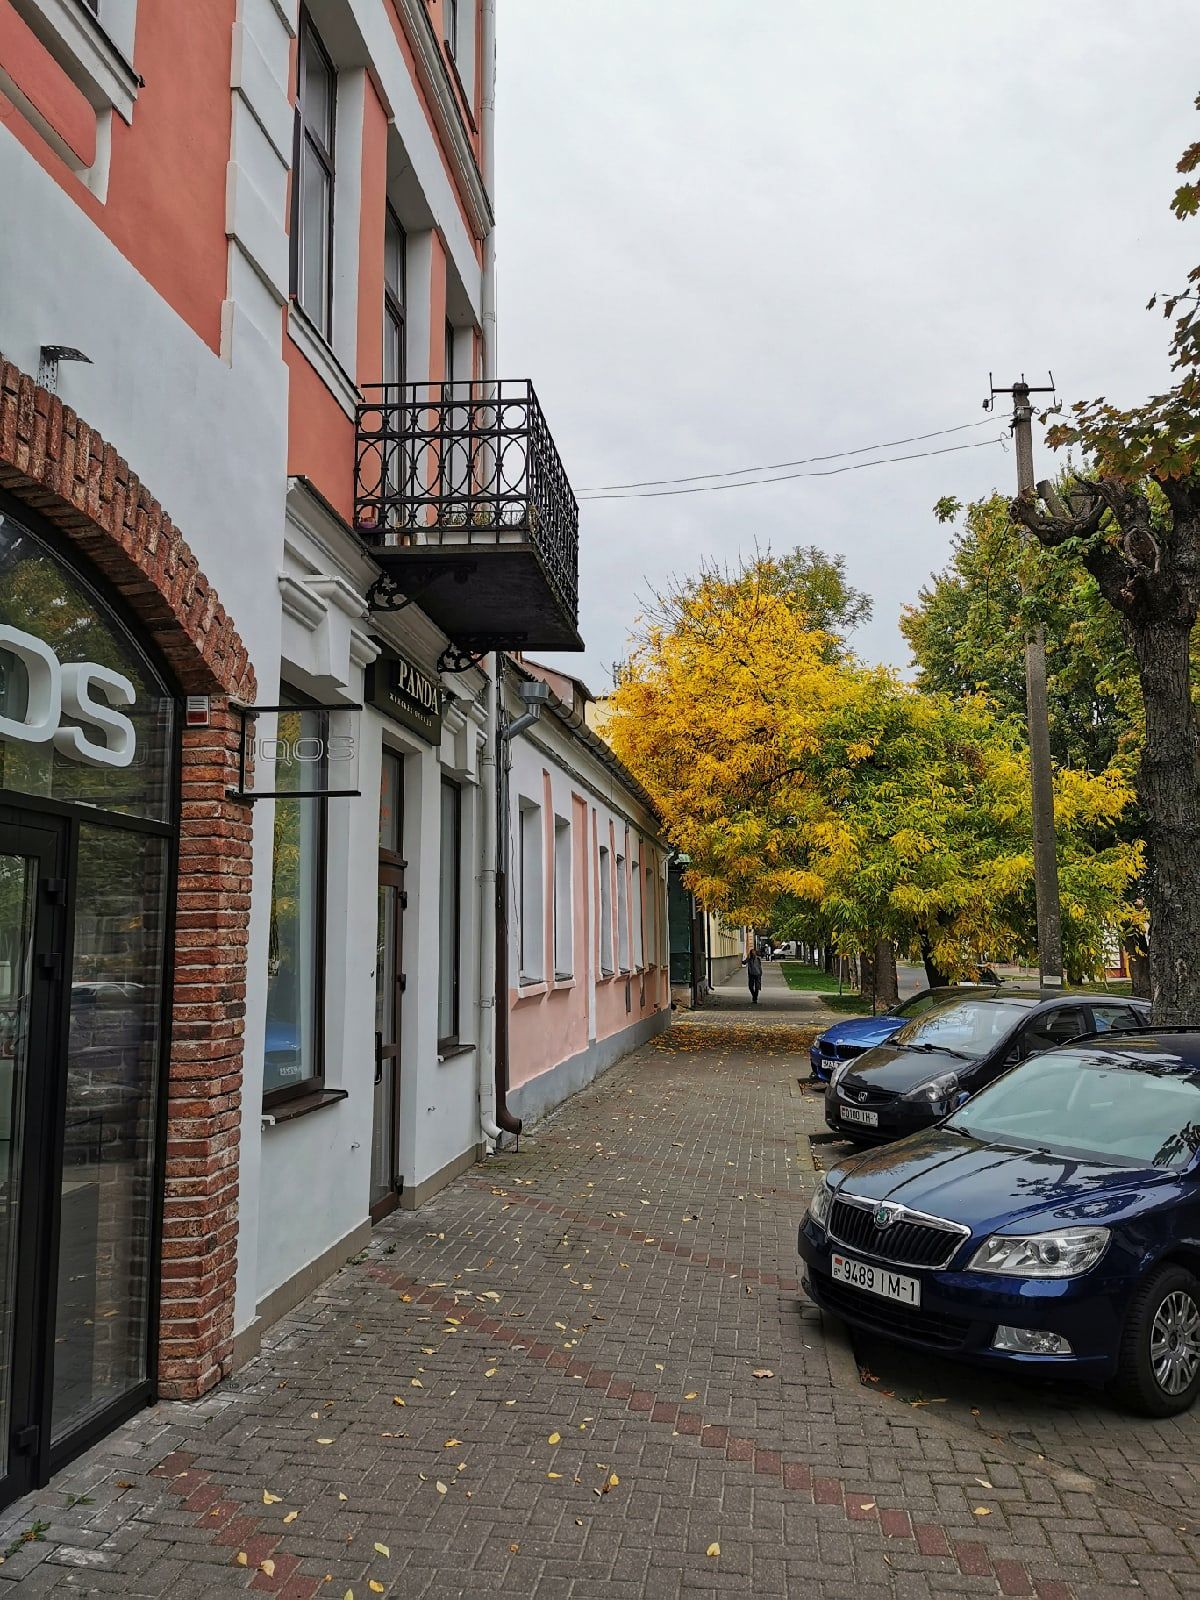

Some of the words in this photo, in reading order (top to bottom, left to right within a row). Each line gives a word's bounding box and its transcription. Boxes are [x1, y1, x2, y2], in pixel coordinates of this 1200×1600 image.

[398, 659, 439, 715] PANDA
[249, 736, 355, 766] IQOS
[844, 1260, 875, 1289] 9489
